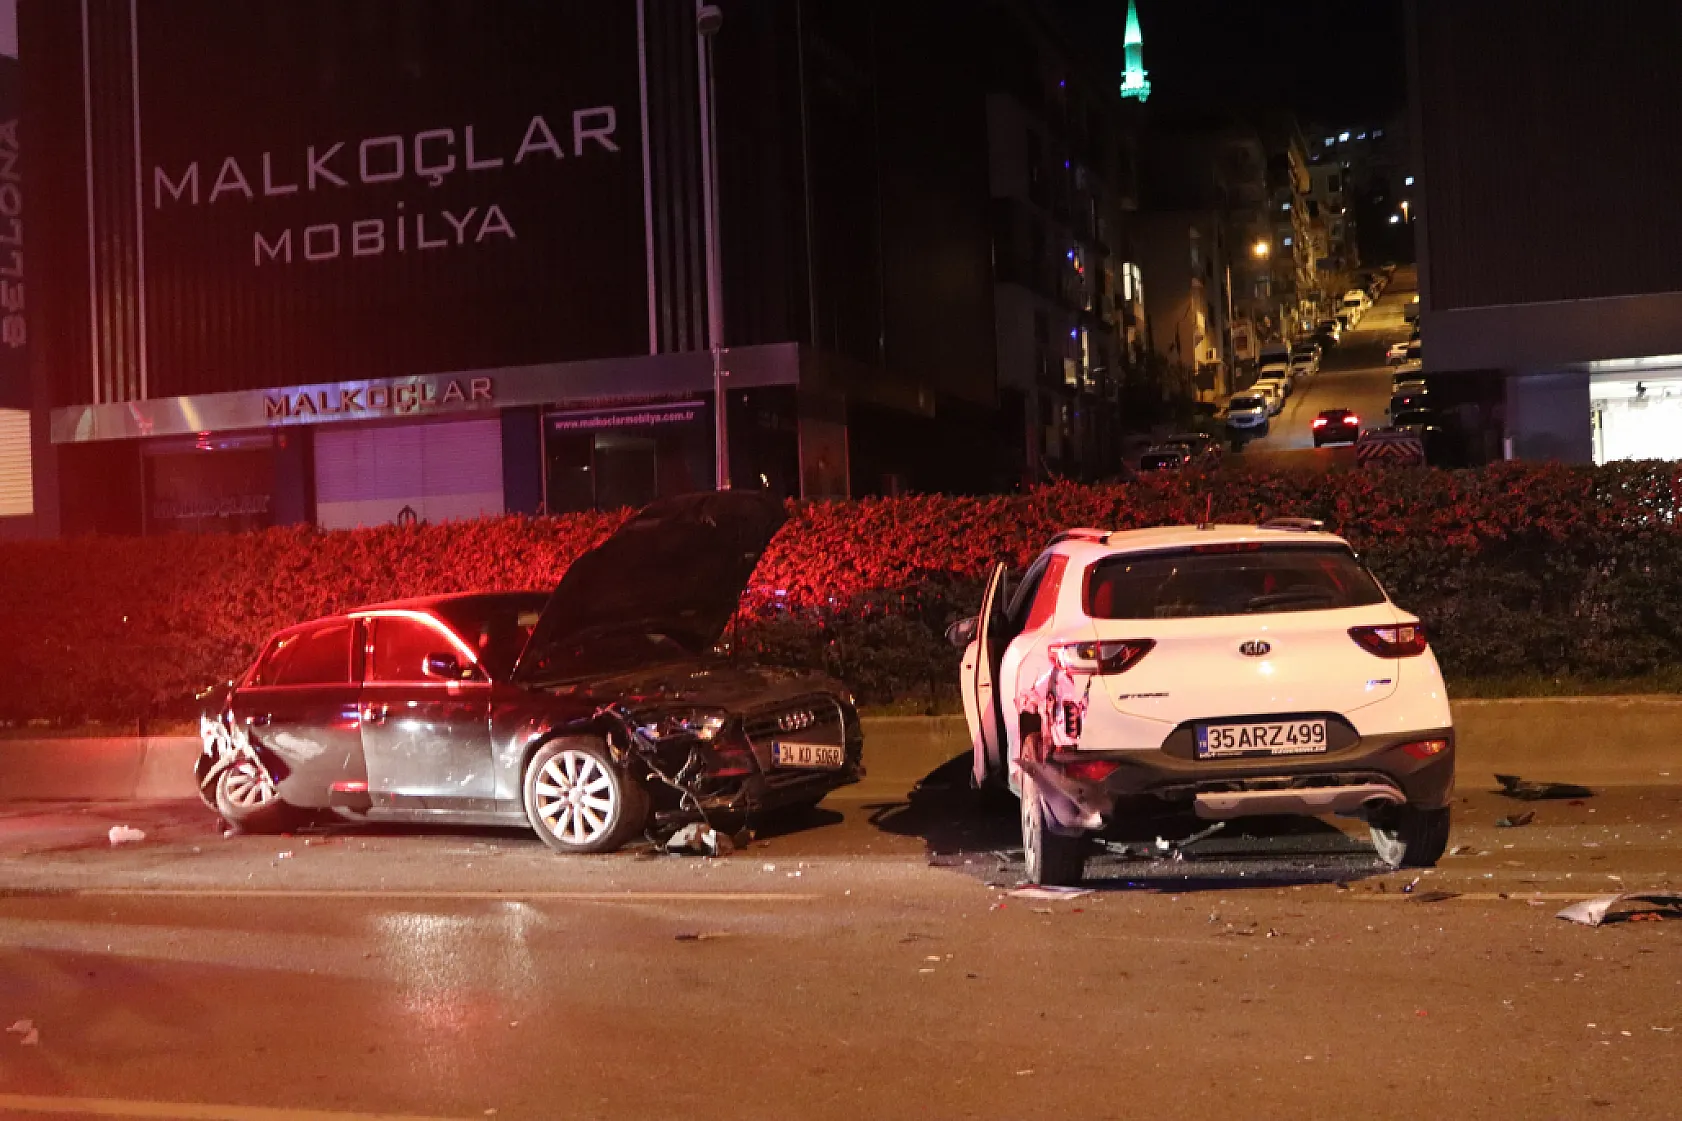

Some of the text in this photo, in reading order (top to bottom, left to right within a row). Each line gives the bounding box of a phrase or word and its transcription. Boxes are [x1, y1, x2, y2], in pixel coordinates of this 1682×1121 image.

[153, 105, 620, 209] MALKOÇLAR
[254, 200, 517, 267] MOBİLYA
[264, 376, 494, 420] MALKOÇLAR
